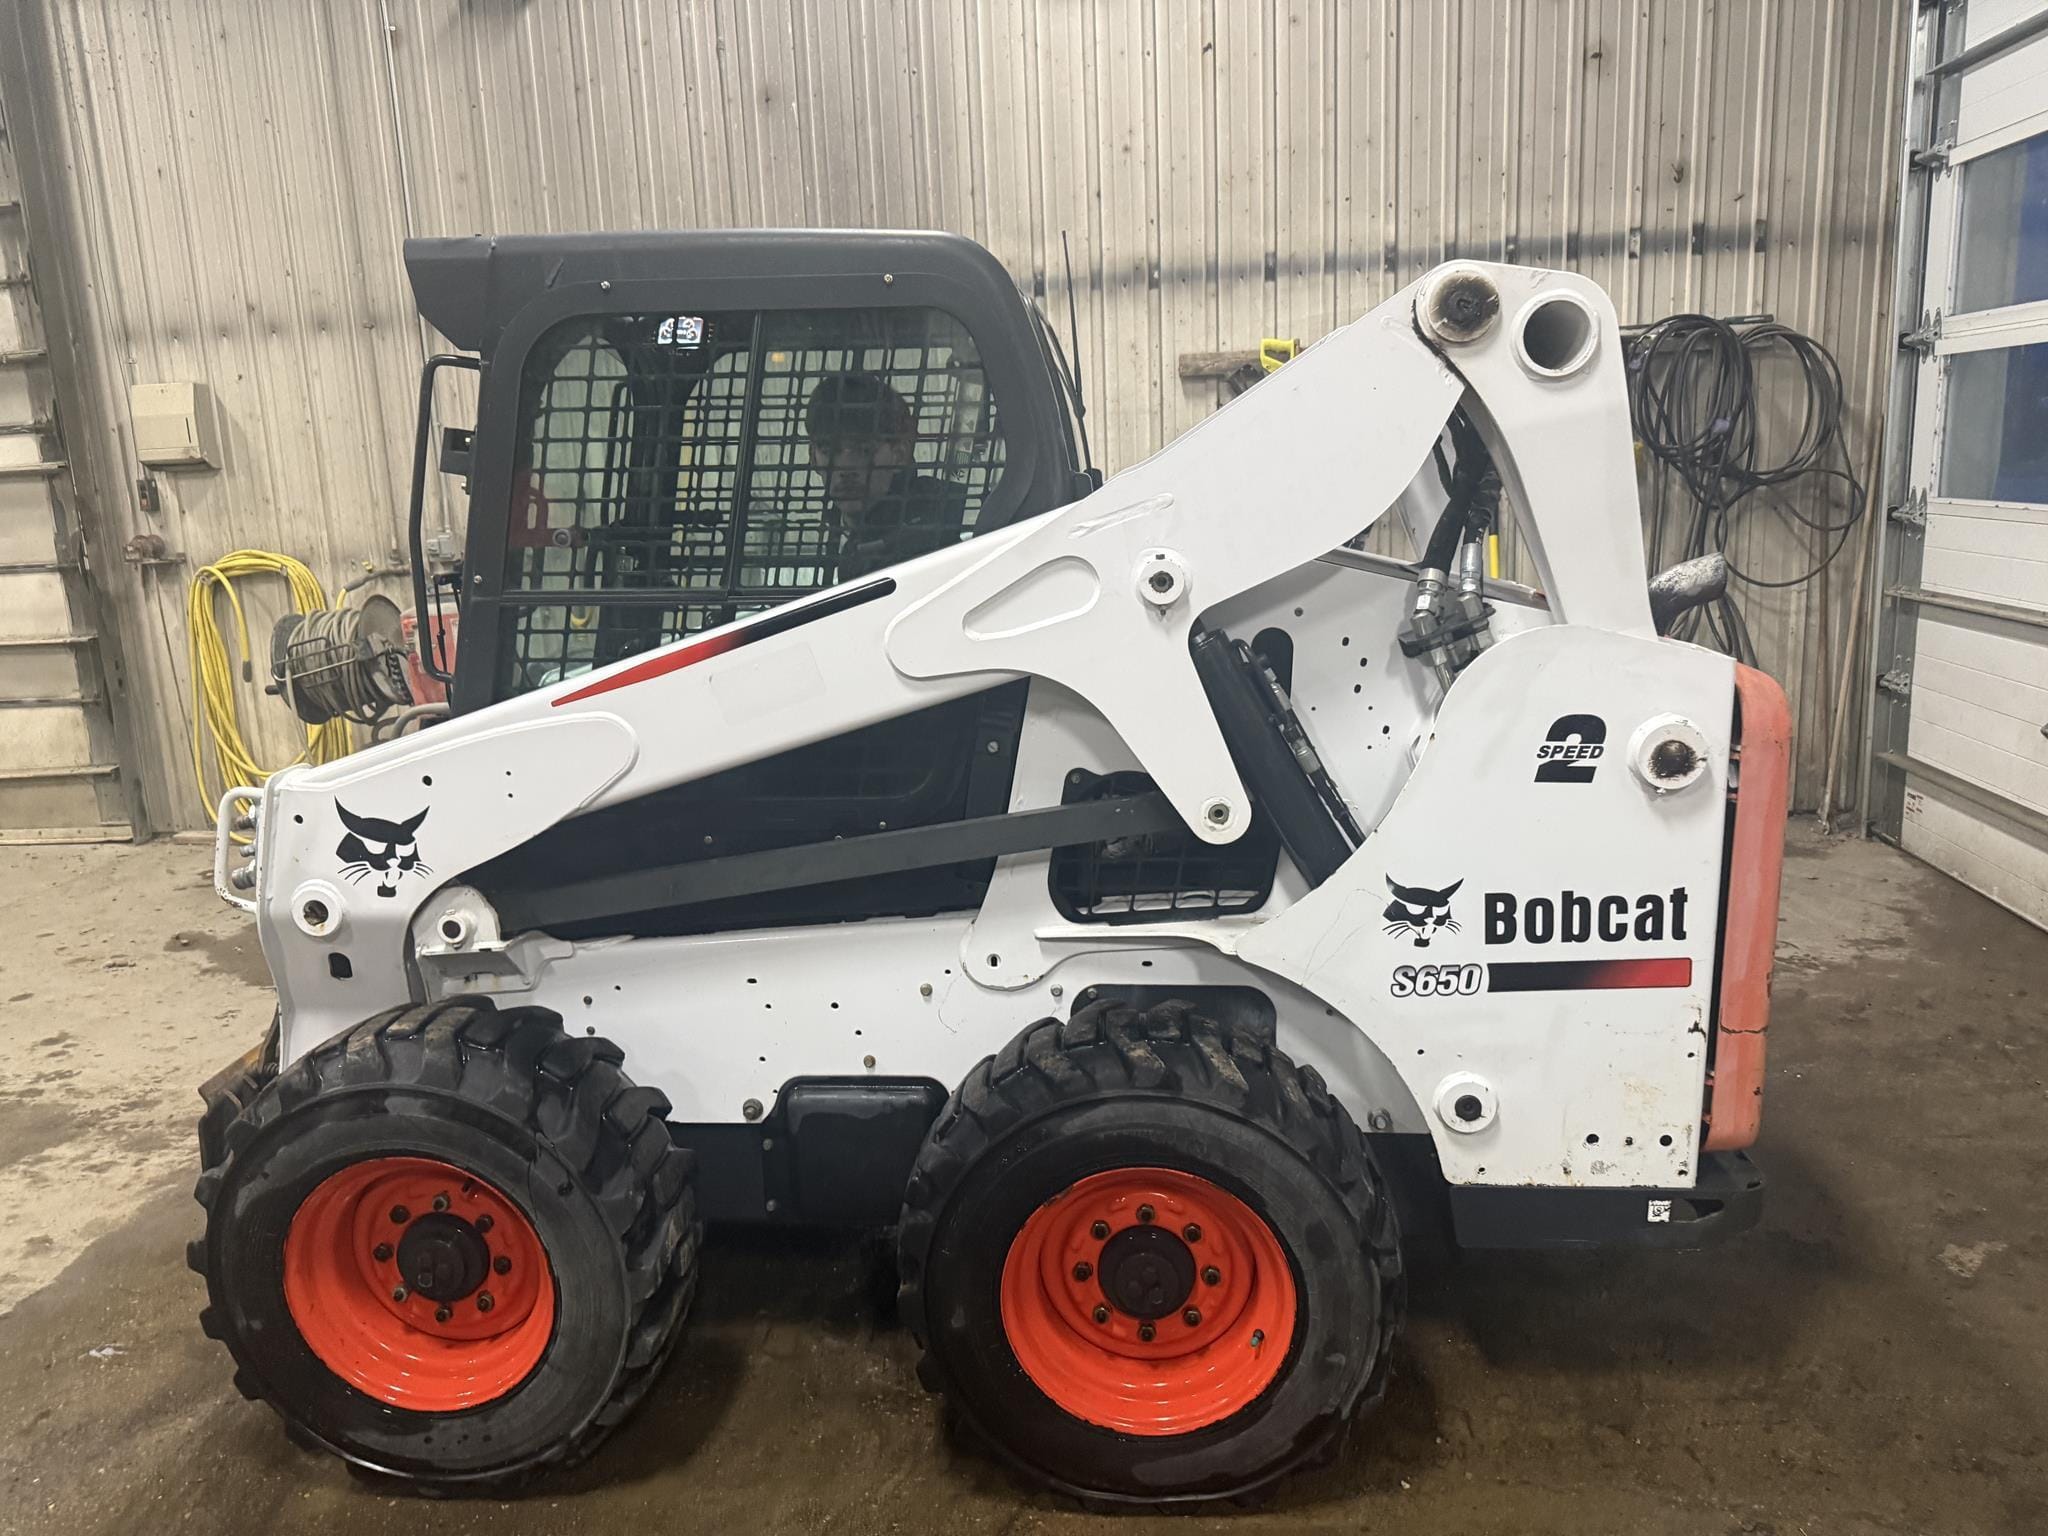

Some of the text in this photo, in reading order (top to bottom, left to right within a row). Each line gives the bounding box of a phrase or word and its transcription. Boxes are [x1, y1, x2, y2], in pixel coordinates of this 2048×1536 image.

[1534, 713, 1607, 783] 2
[1536, 744, 1604, 760] SPEED
[1484, 886, 1688, 945] Bobcat
[1391, 963, 1483, 998] S650
